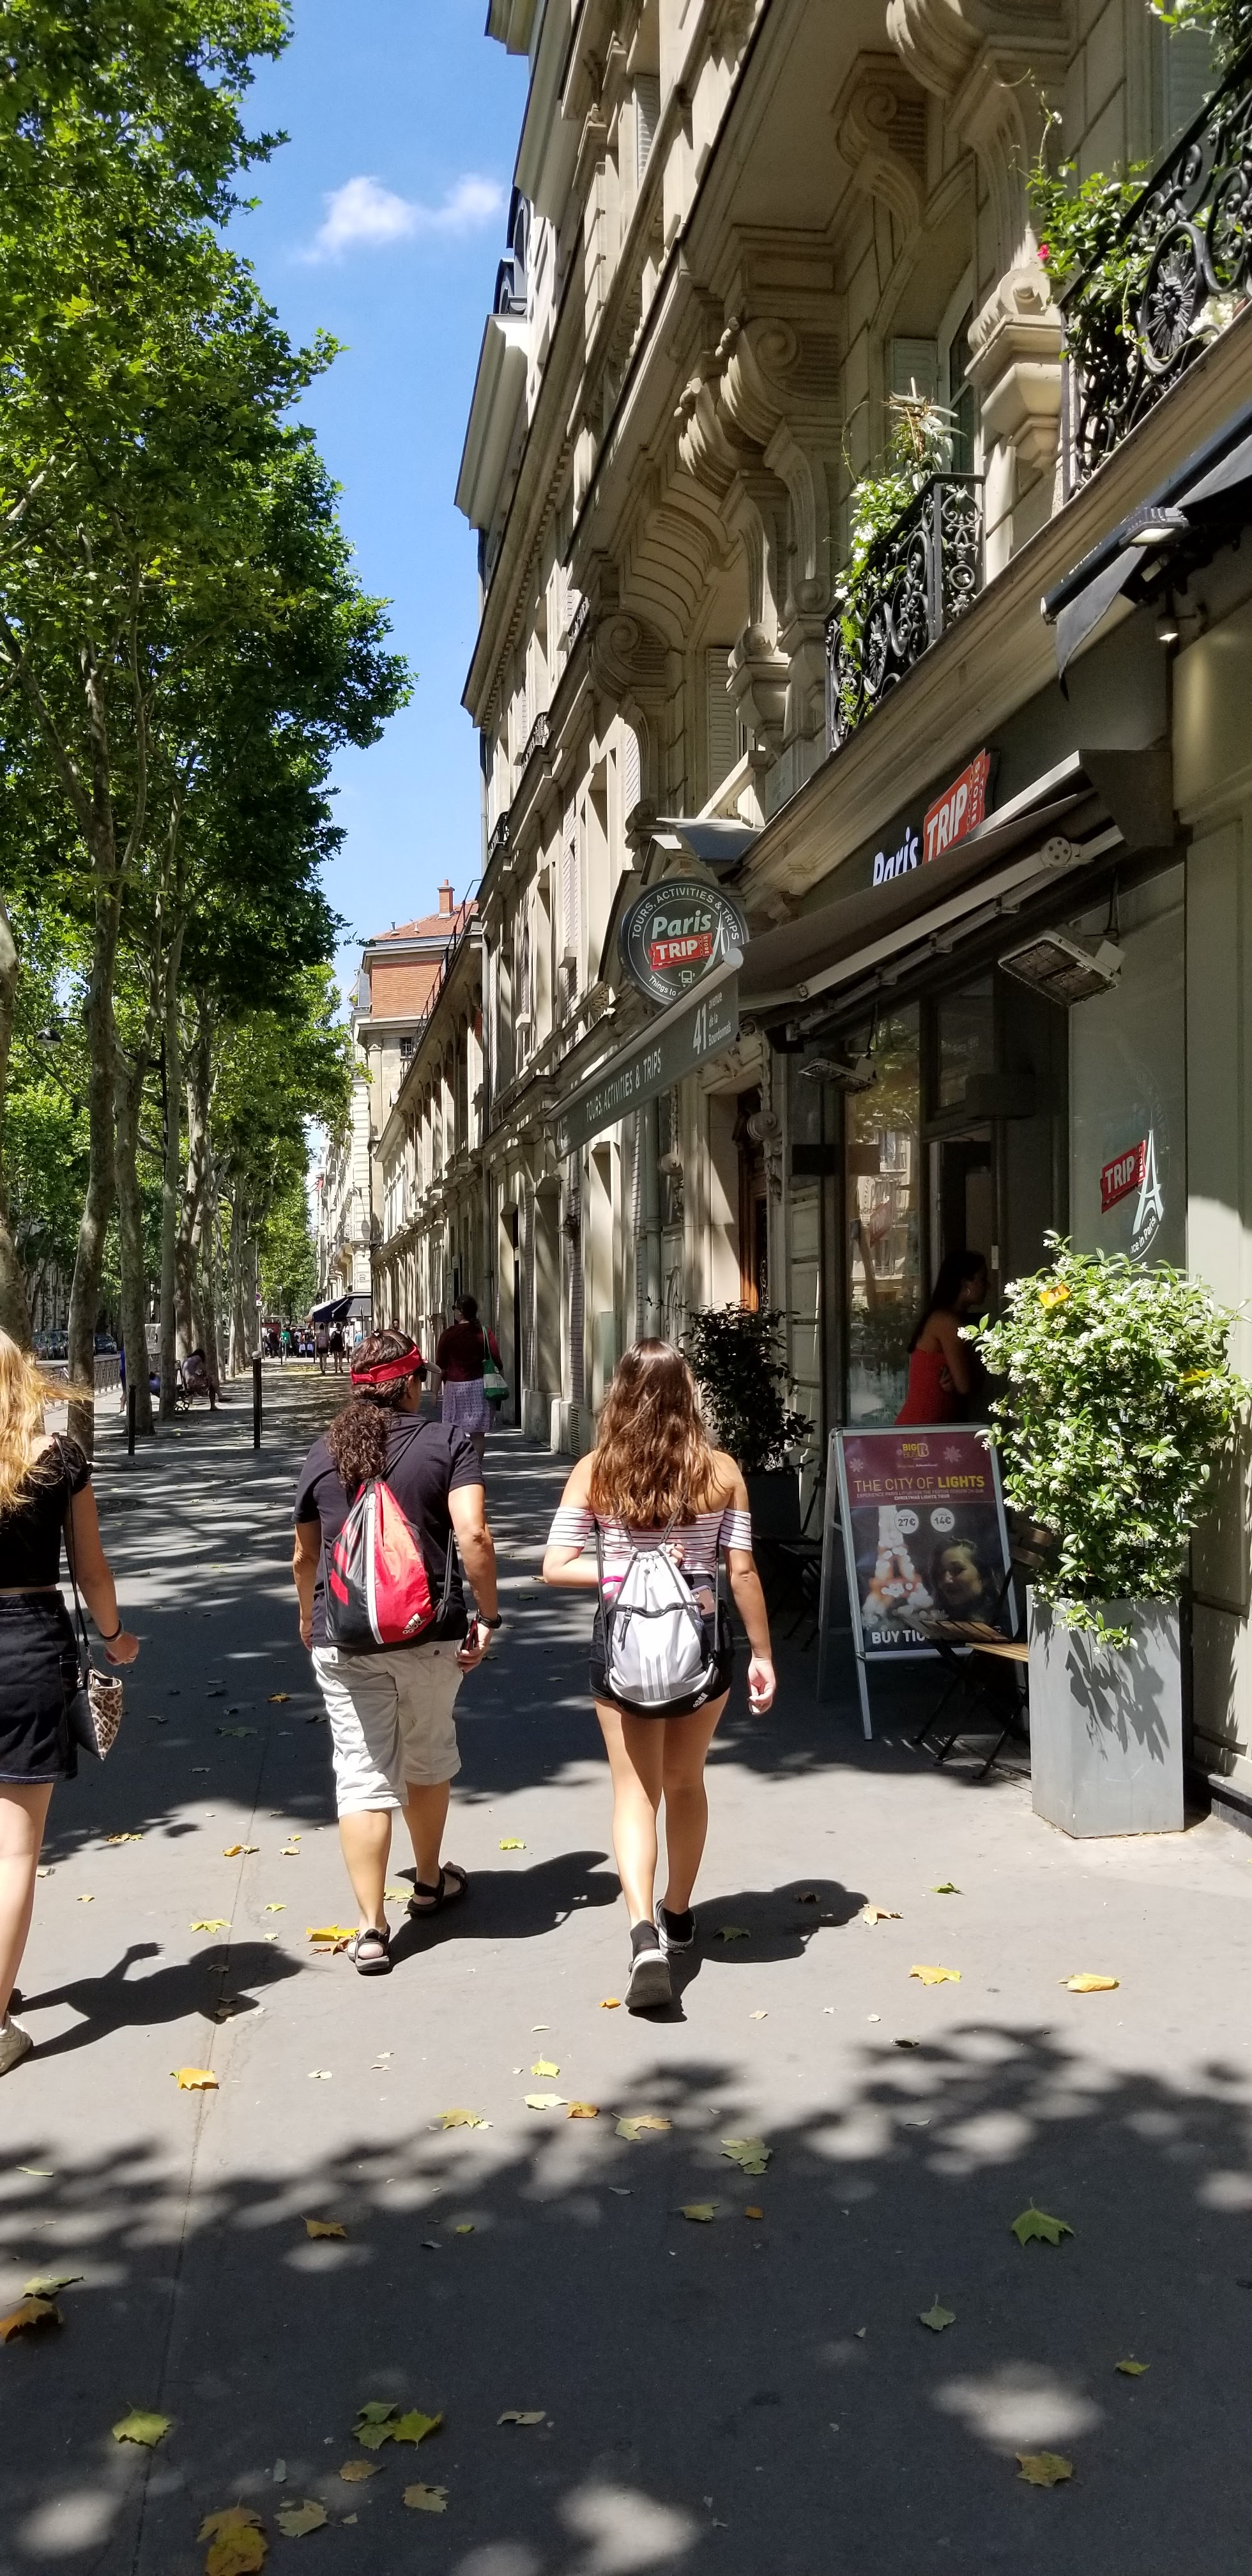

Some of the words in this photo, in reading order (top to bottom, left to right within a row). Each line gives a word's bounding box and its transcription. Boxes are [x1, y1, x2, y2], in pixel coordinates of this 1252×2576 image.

[972, 761, 981, 825] STORE
[873, 826, 919, 887] Paris
[927, 783, 967, 862] TRIP
[632, 901, 657, 939] TOURS,
[655, 887, 714, 903] ACTIVITIES
[714, 901, 722, 910] &
[722, 908, 739, 940] TRIPS
[652, 910, 712, 940] Paris
[655, 940, 698, 960] TRIP
[648, 975, 668, 993] Things
[669, 988, 676, 996] to
[708, 992, 722, 1009] avenue
[692, 1004, 706, 1055] 41
[708, 1015, 714, 1028] de
[604, 1070, 632, 1111] ACTIVITIES
[635, 1064, 641, 1089] &
[643, 1048, 662, 1084] TRIPS
[1104, 1155, 1135, 1193] TRIP
[1138, 1236, 1145, 1248] in
[1143, 1215, 1156, 1240] Paris
[903, 1443, 917, 1452] BIG
[854, 1479, 882, 1492] THE
[885, 1477, 913, 1491] CITY
[917, 1476, 934, 1489] OF
[938, 1475, 985, 1489] LIGHTS
[935, 1517, 952, 1525] 14€
[402, 1617, 427, 1634] adidas
[871, 1630, 899, 1644] BUY
